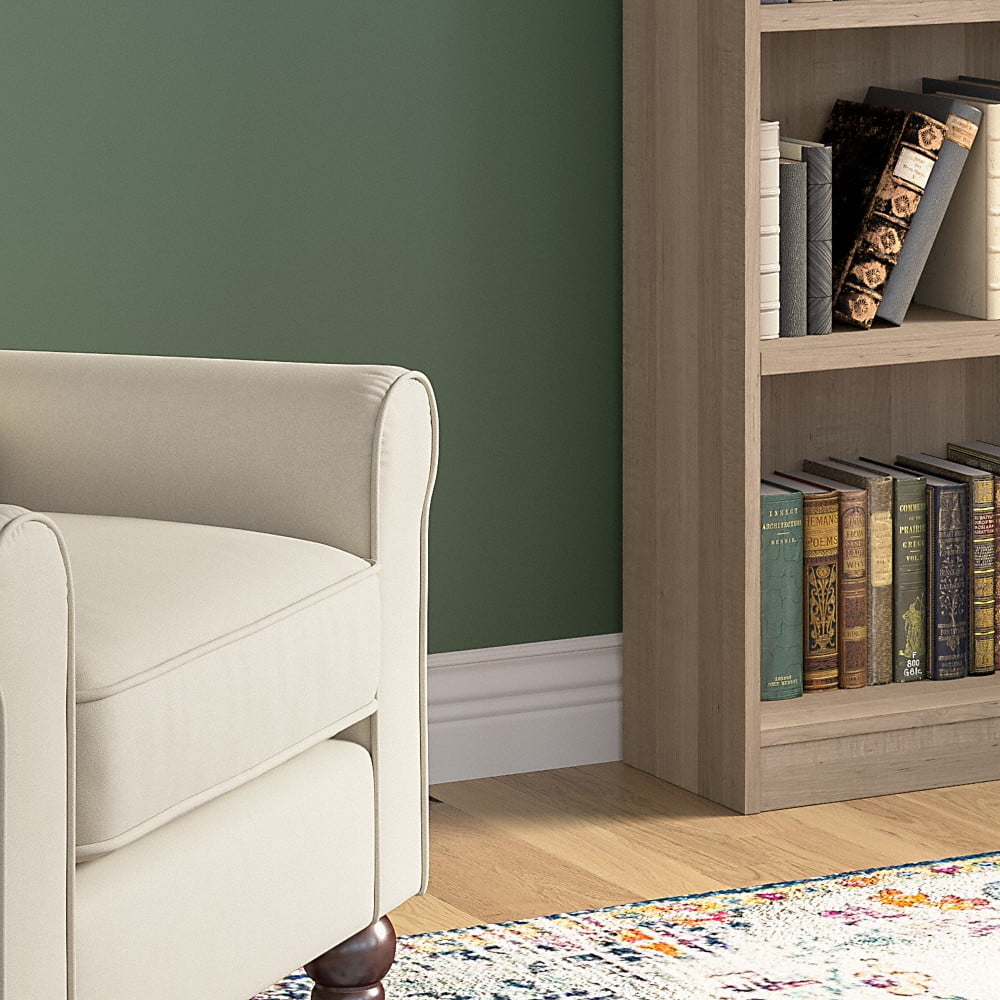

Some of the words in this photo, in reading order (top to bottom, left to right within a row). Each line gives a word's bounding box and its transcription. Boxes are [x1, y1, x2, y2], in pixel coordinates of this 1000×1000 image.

[807, 536, 838, 548] POEMS
[912, 651, 918, 659] F
[906, 658, 920, 668] 800
